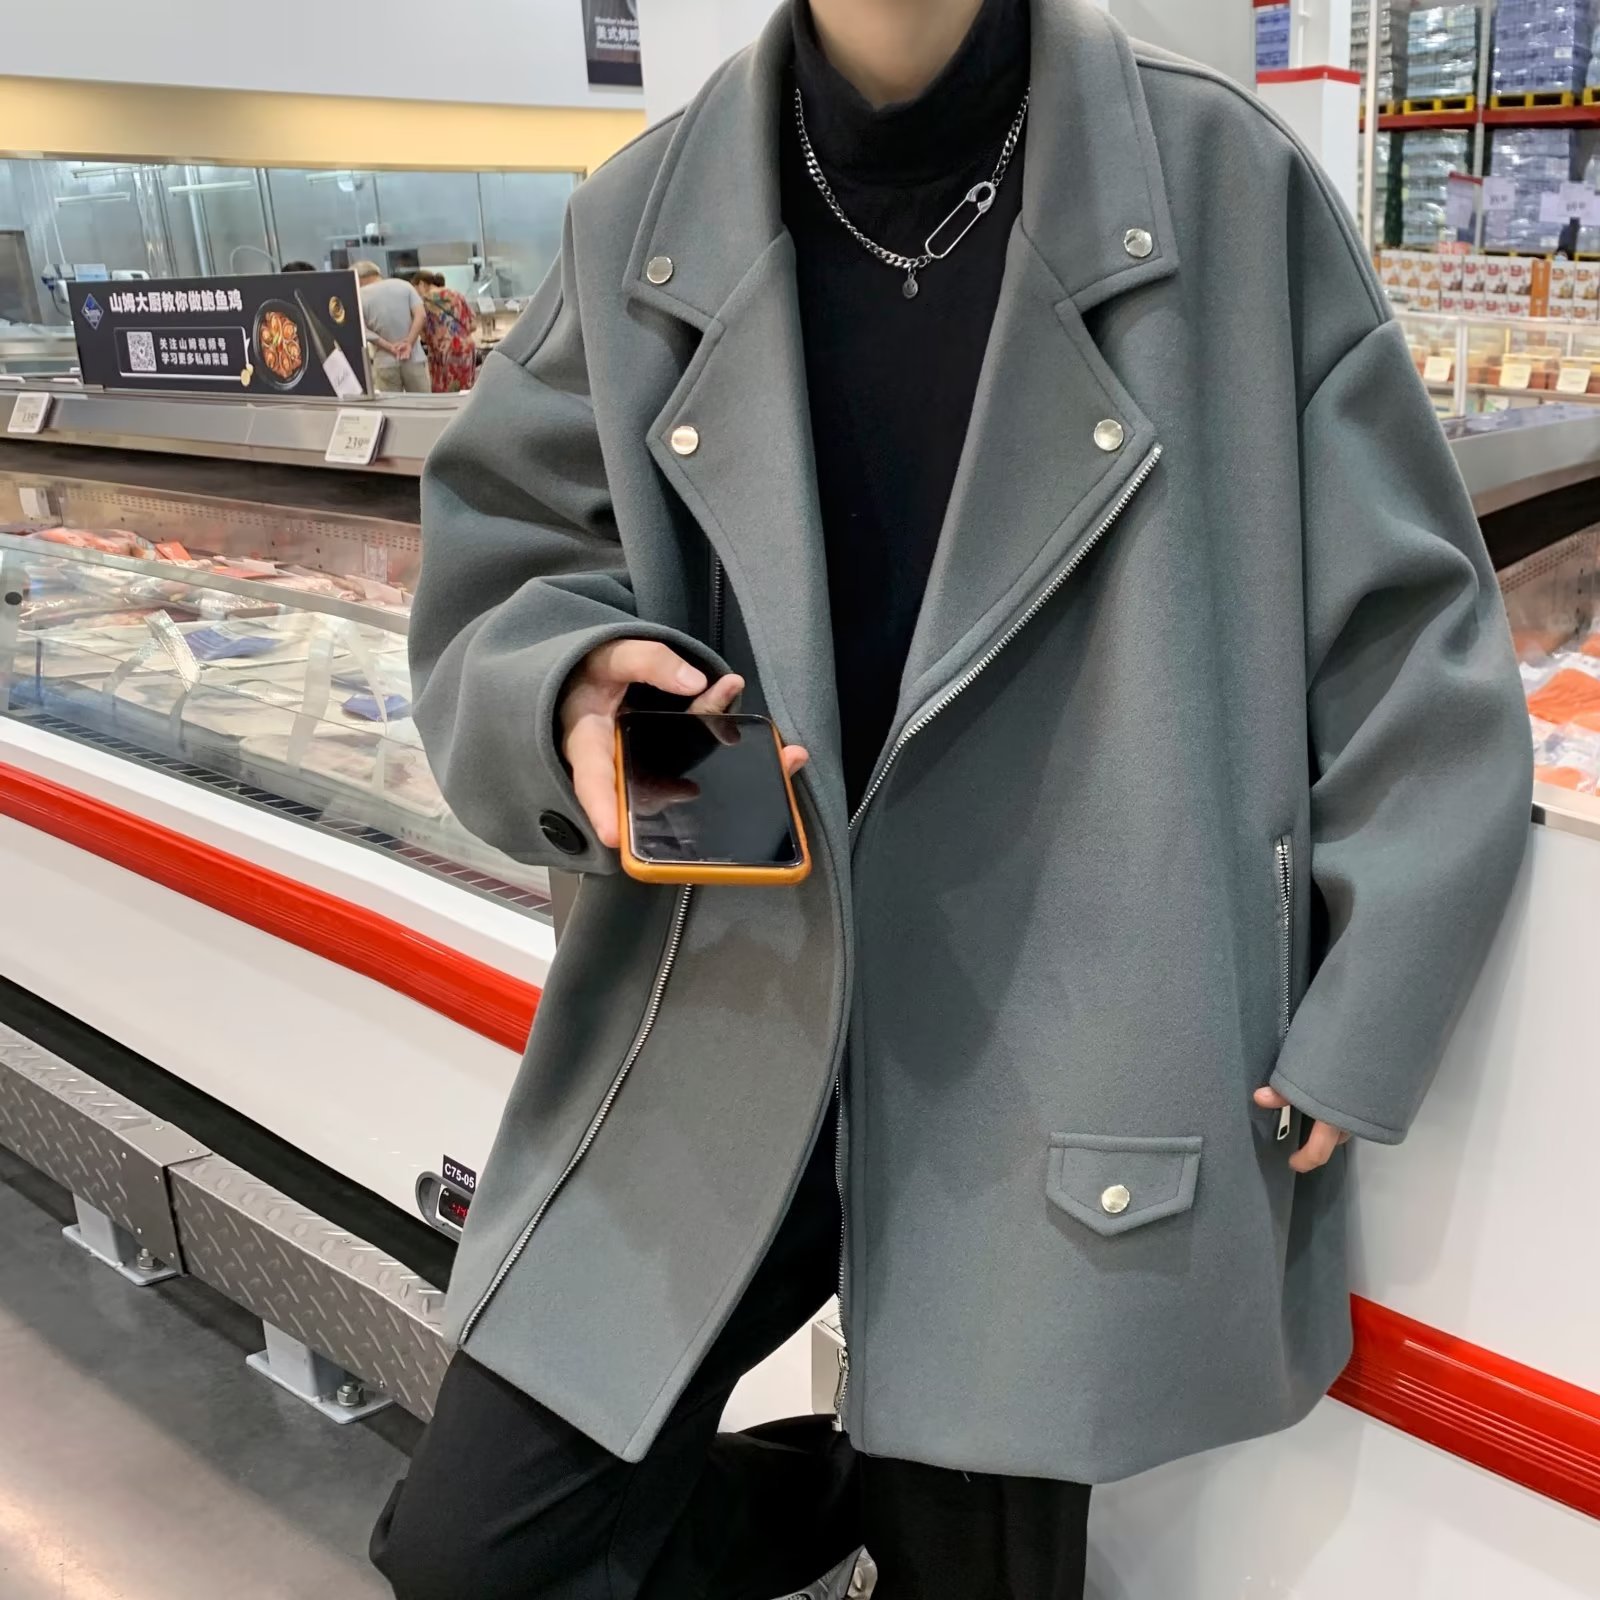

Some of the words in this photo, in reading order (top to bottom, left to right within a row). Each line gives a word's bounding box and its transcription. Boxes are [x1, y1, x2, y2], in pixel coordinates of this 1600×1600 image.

[109, 289, 242, 313] 山姆大厨教你做鲍鱼鸡
[159, 337, 226, 351] 关注山姆视频号
[444, 1162, 475, 1189] C75-05
